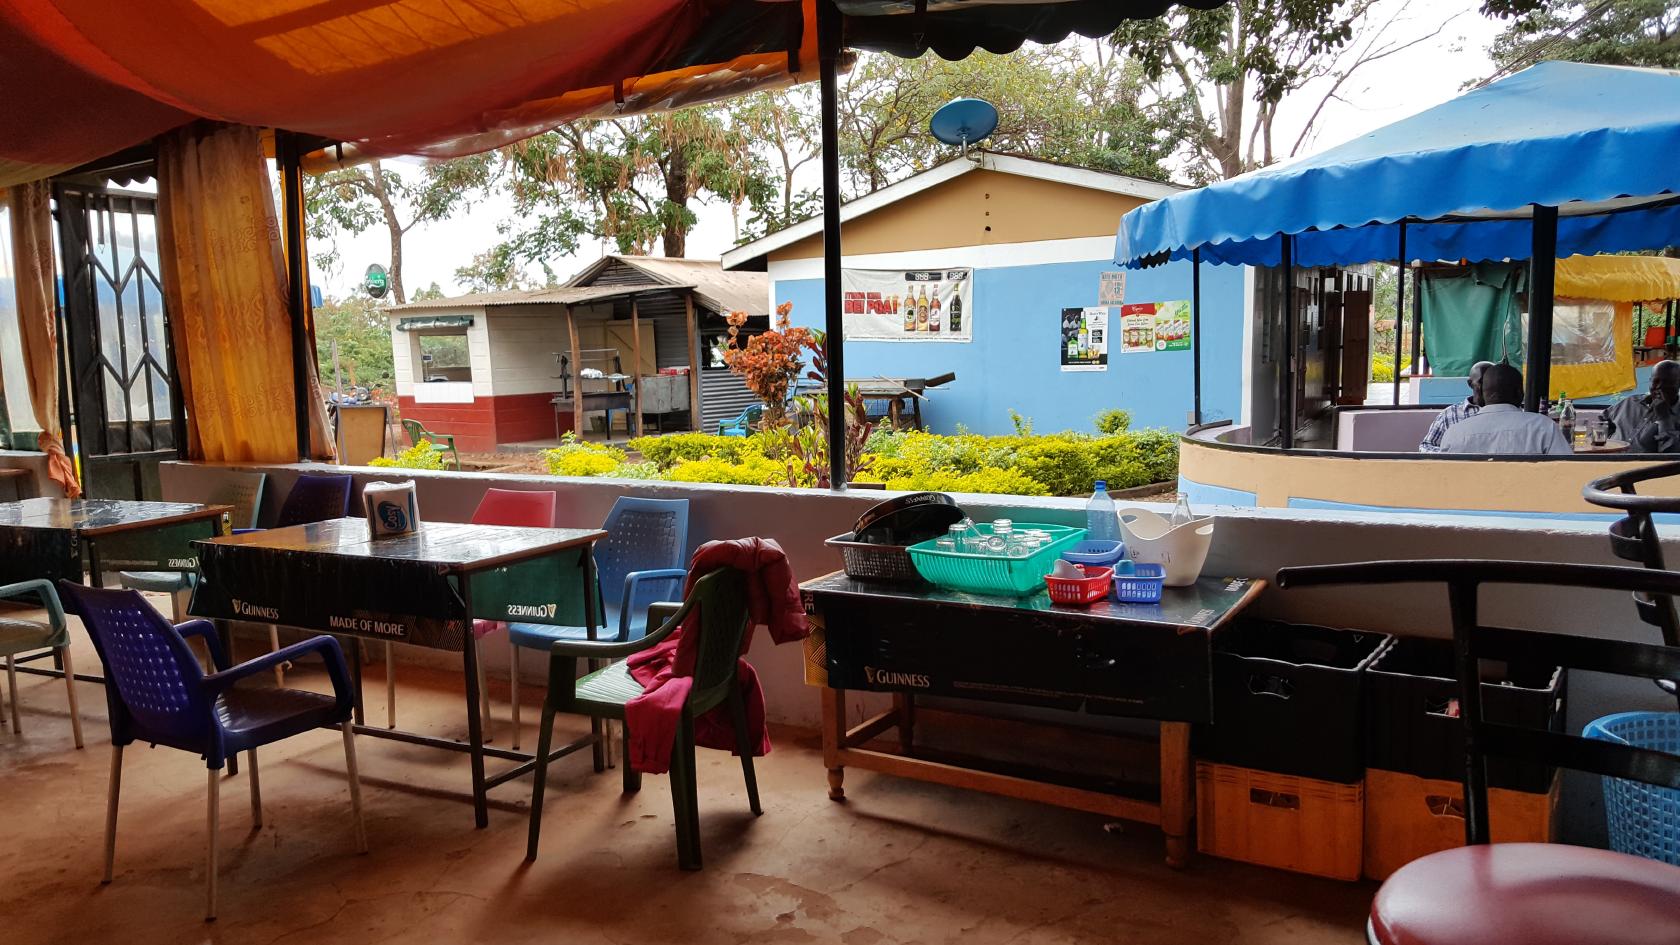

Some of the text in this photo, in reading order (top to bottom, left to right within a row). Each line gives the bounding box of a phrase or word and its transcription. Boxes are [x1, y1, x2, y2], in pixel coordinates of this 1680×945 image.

[844, 300, 865, 315] BEI
[241, 601, 279, 620] GUINNESS
[329, 615, 405, 636] MADE OF MORE
[876, 669, 931, 688] GUINNESS
